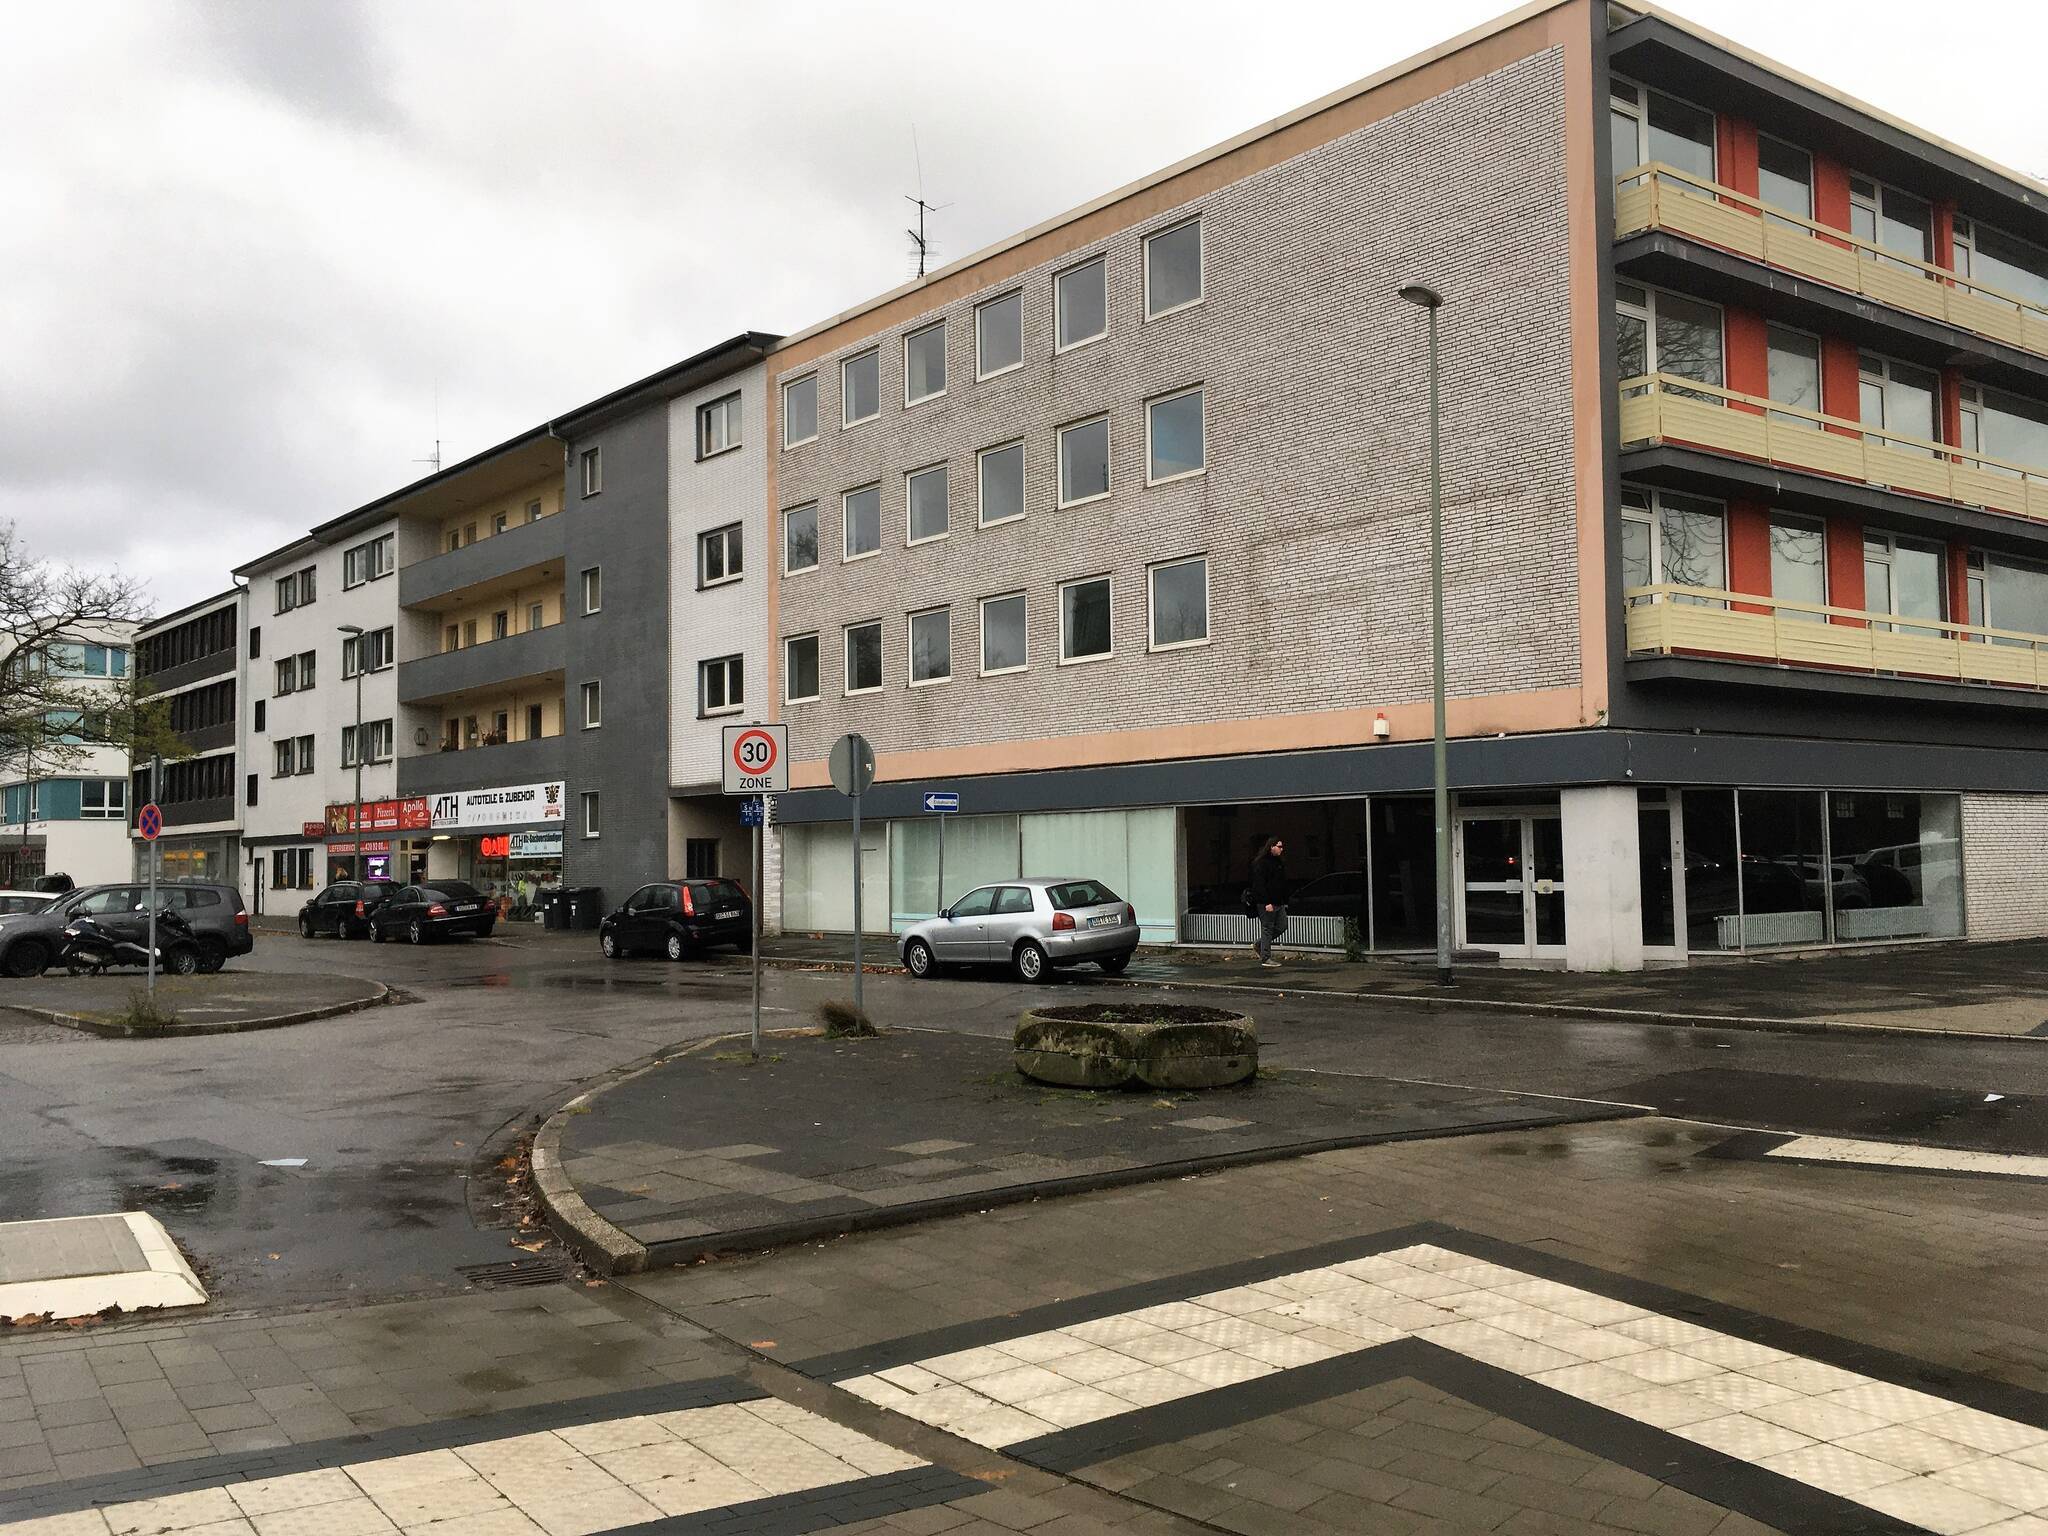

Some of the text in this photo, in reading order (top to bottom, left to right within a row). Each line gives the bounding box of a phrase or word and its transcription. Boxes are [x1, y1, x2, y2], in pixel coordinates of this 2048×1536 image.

[742, 742, 768, 762] 30
[739, 777, 772, 789] ZONE
[466, 793, 497, 806] AUTOTEILE
[499, 793, 504, 803] &
[377, 806, 395, 818] Pizzeria
[402, 800, 424, 816] Apollo
[432, 795, 458, 819] ATH
[510, 834, 523, 848] ATH
